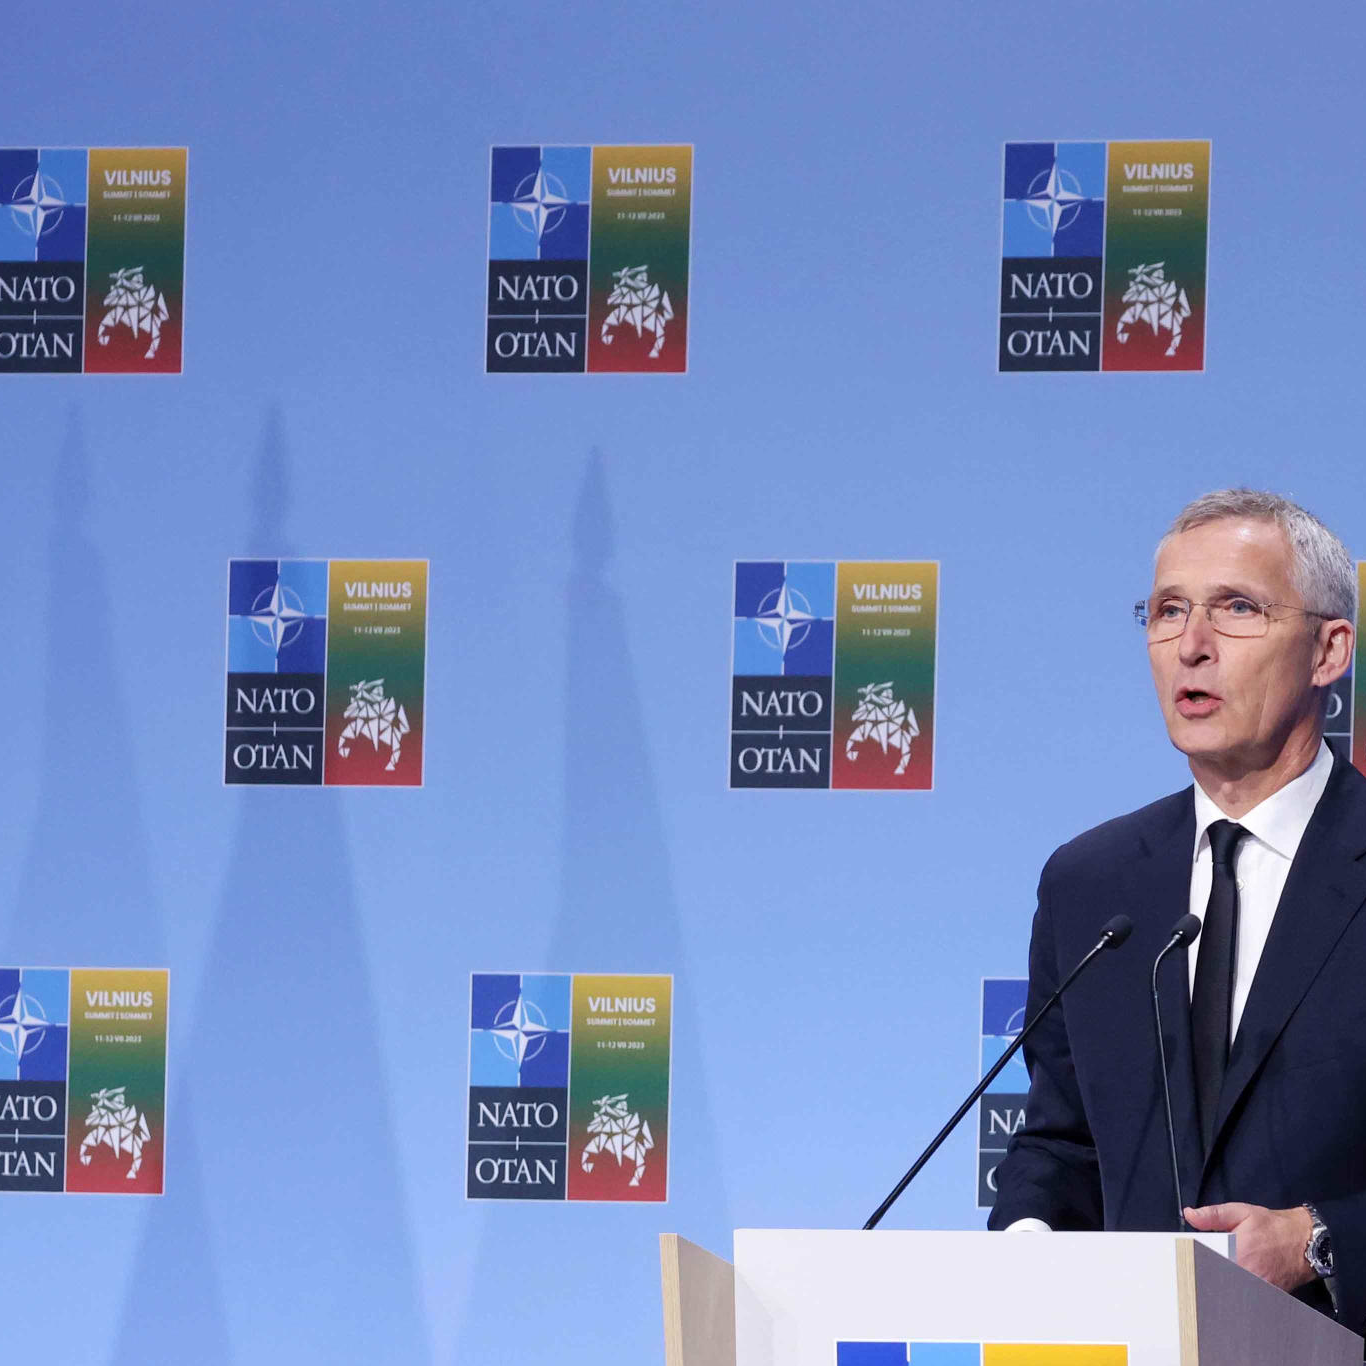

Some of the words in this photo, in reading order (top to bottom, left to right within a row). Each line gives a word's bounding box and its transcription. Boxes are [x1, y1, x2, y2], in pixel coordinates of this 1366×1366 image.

[104, 169, 171, 186] VILNIUS
[607, 167, 677, 184] VILNIUS
[1124, 163, 1194, 179] VILNIUS
[498, 275, 578, 300] NATO
[1011, 273, 1092, 298] NATO
[495, 332, 576, 357] OTAN
[1008, 330, 1090, 355] OTAN
[344, 581, 411, 598] VILNIUS
[853, 583, 922, 600] VILNIUS
[236, 688, 315, 713] NATO
[741, 691, 822, 716] NATO
[233, 744, 313, 769] OTAN
[739, 748, 821, 773] OTAN
[85, 991, 153, 1007] VILNIUS
[588, 996, 656, 1013] VILNIUS
[478, 1102, 558, 1127] NATO
[989, 1109, 1026, 1135] NA
[476, 1159, 556, 1184] OTAN
